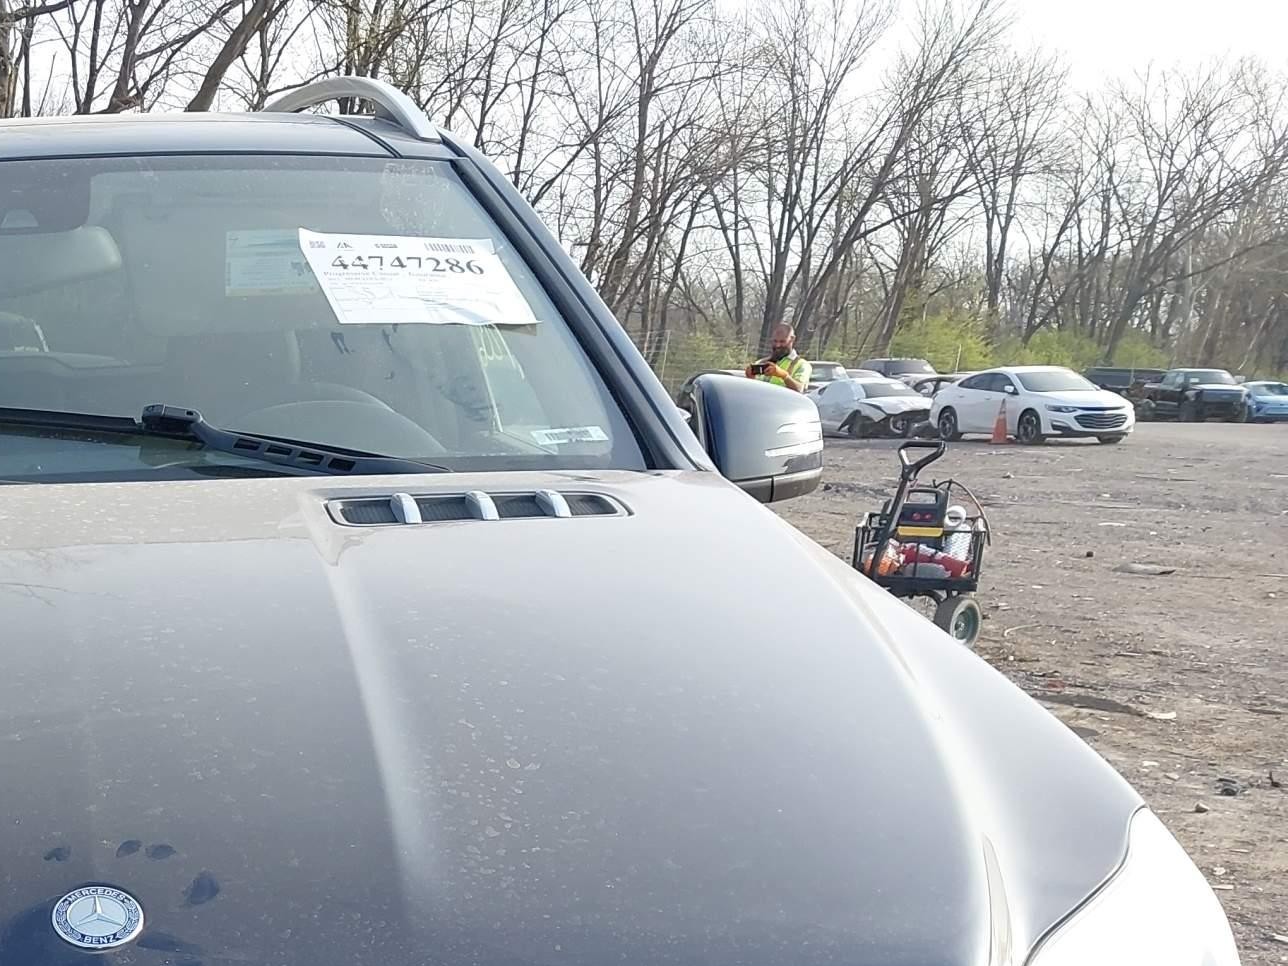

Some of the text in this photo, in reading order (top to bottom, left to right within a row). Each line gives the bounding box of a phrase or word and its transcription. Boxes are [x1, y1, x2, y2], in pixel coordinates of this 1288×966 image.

[331, 255, 485, 275] 44747286
[65, 887, 126, 903] MERCEDES
[83, 935, 117, 945] BENZ
